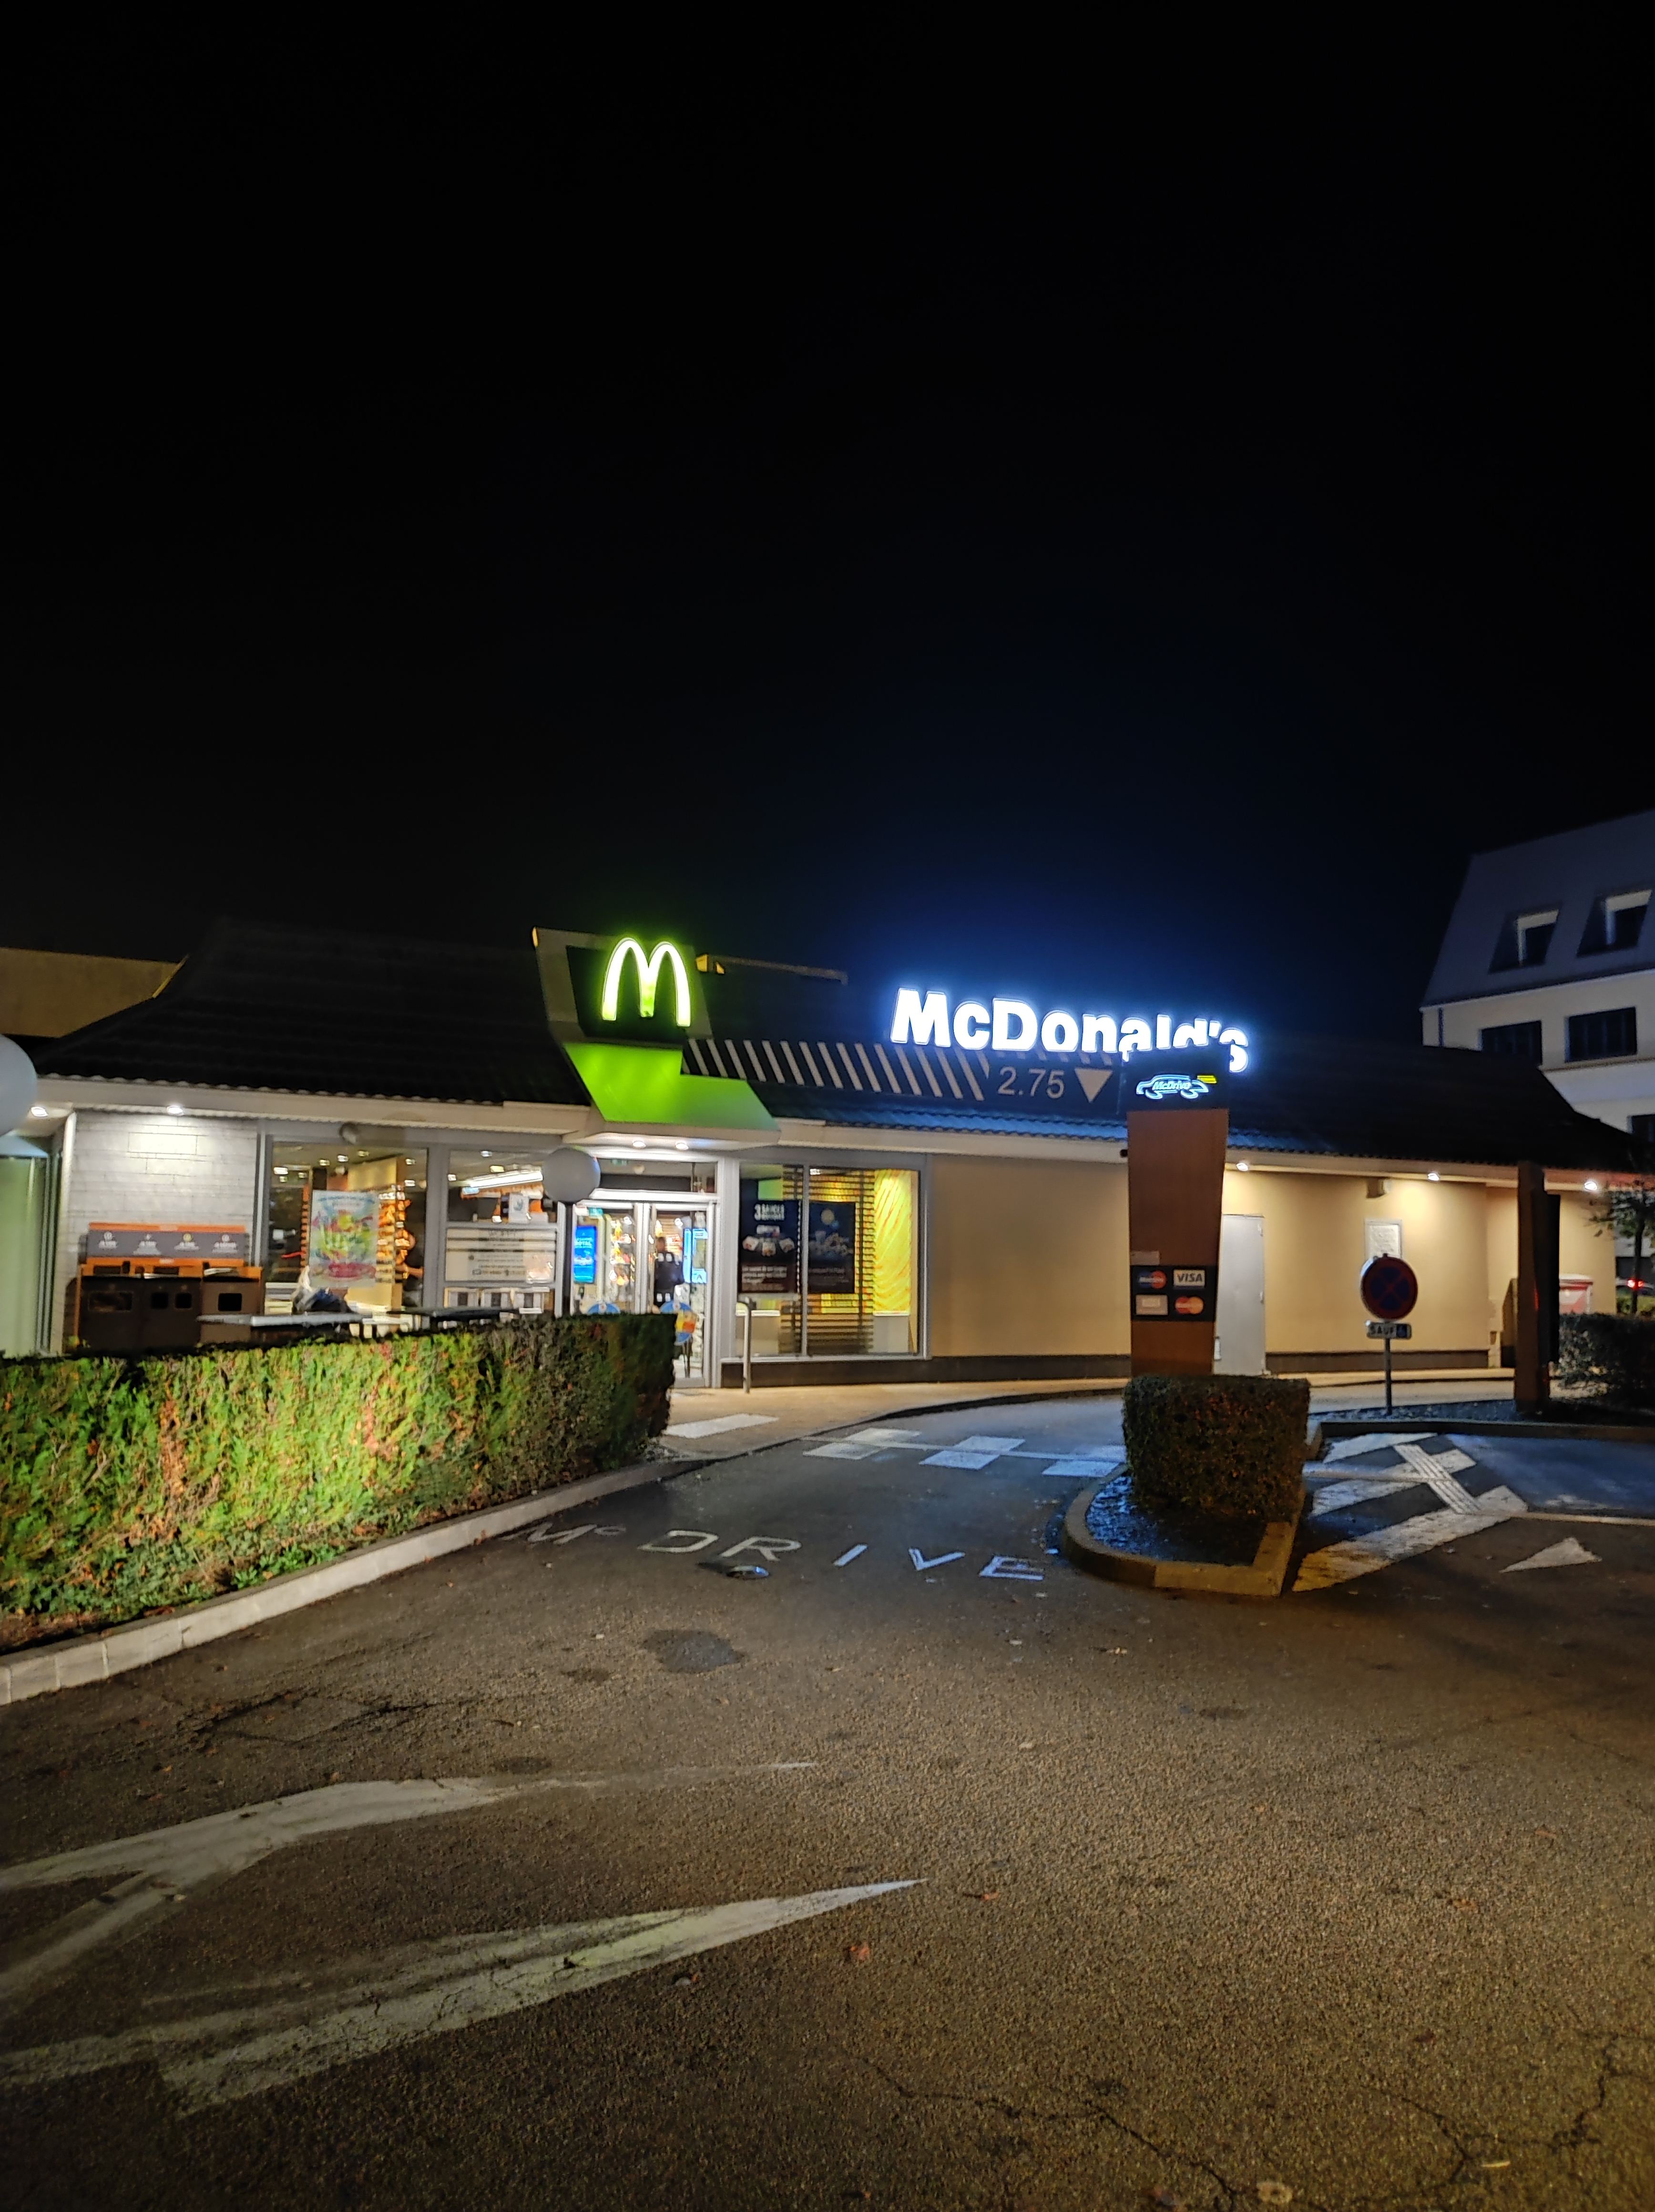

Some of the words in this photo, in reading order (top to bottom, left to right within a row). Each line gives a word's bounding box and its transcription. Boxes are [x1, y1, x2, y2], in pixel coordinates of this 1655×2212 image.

[997, 1066, 1065, 1099] 2.75
[1152, 1081, 1191, 1090] McDrive
[1177, 1273, 1203, 1282] VISA
[637, 1529, 1044, 1581] DRIVE
